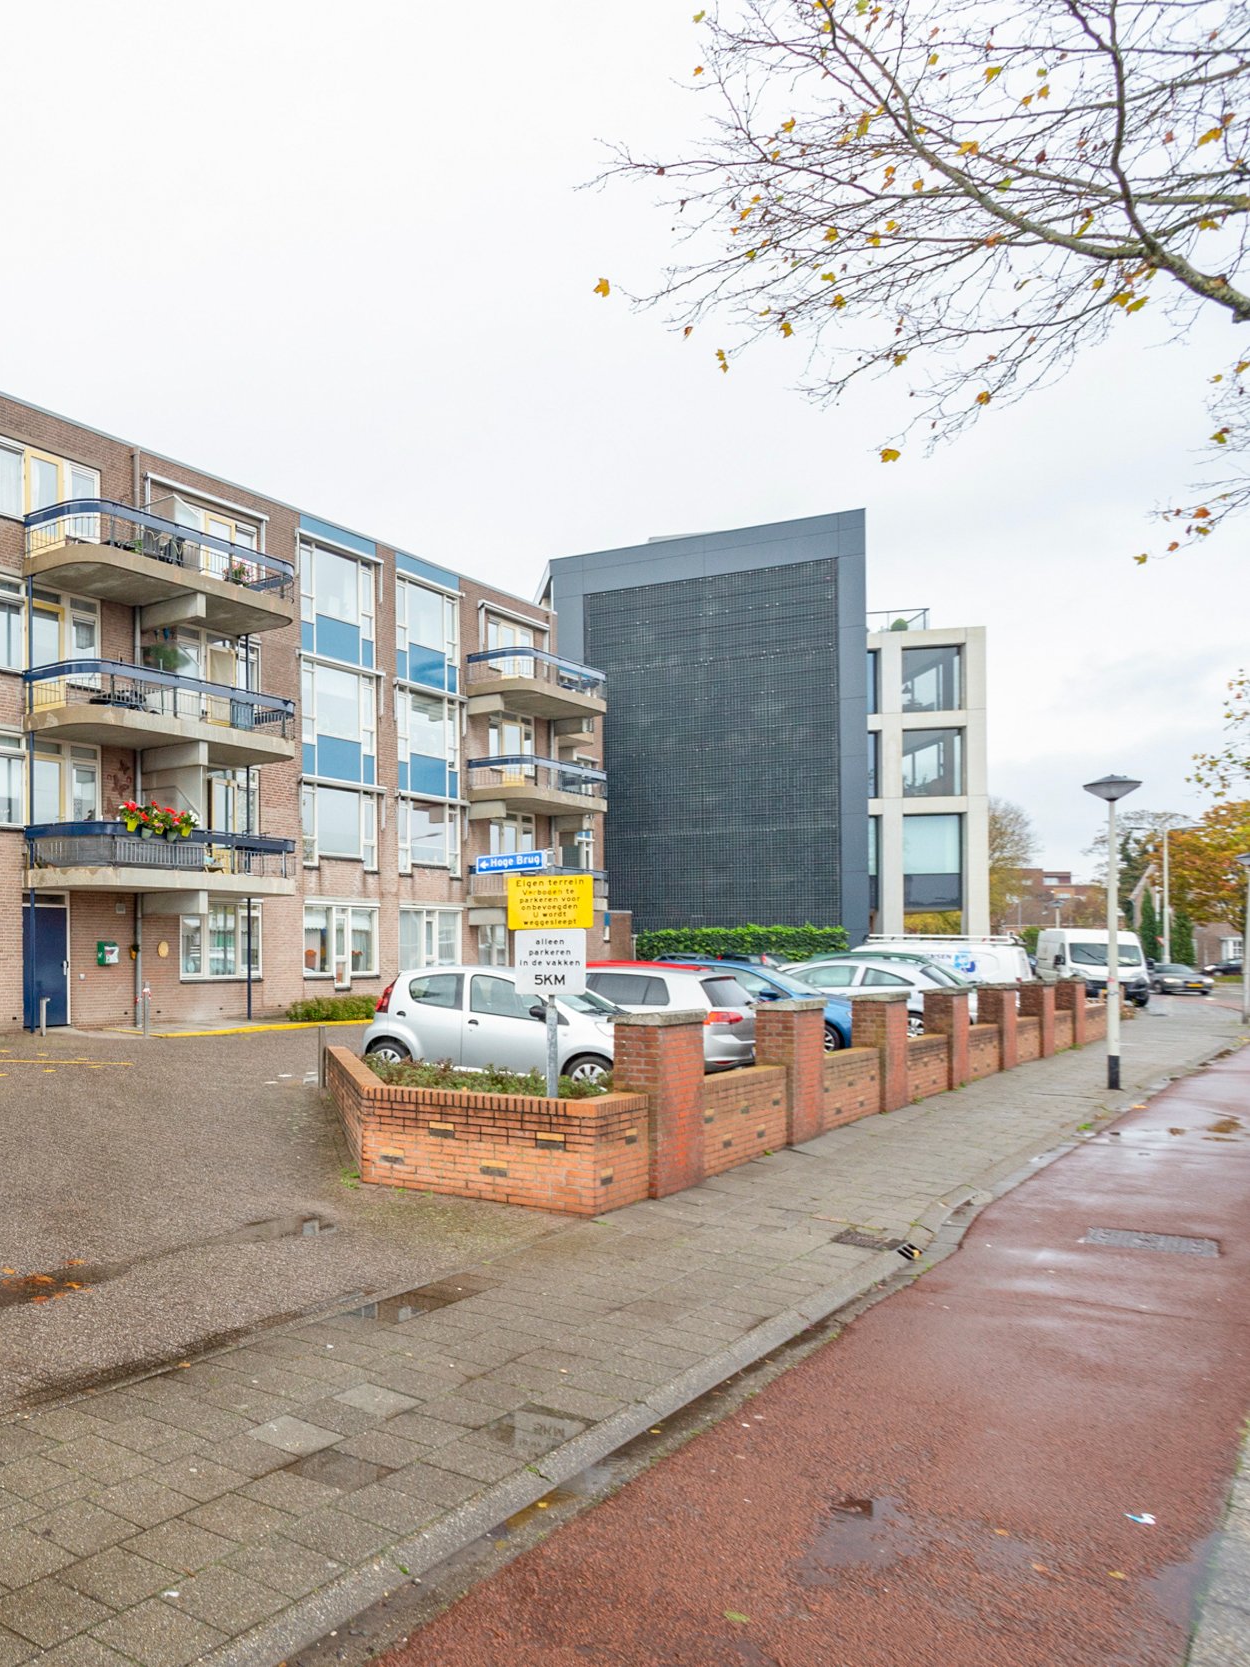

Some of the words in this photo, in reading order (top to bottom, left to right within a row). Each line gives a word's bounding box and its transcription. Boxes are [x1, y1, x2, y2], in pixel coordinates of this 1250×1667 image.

[490, 858, 514, 868] Hoge
[516, 856, 540, 865] Brug
[516, 880, 544, 888] Eigen
[548, 878, 584, 886] terrein
[534, 974, 566, 986] 5KM
